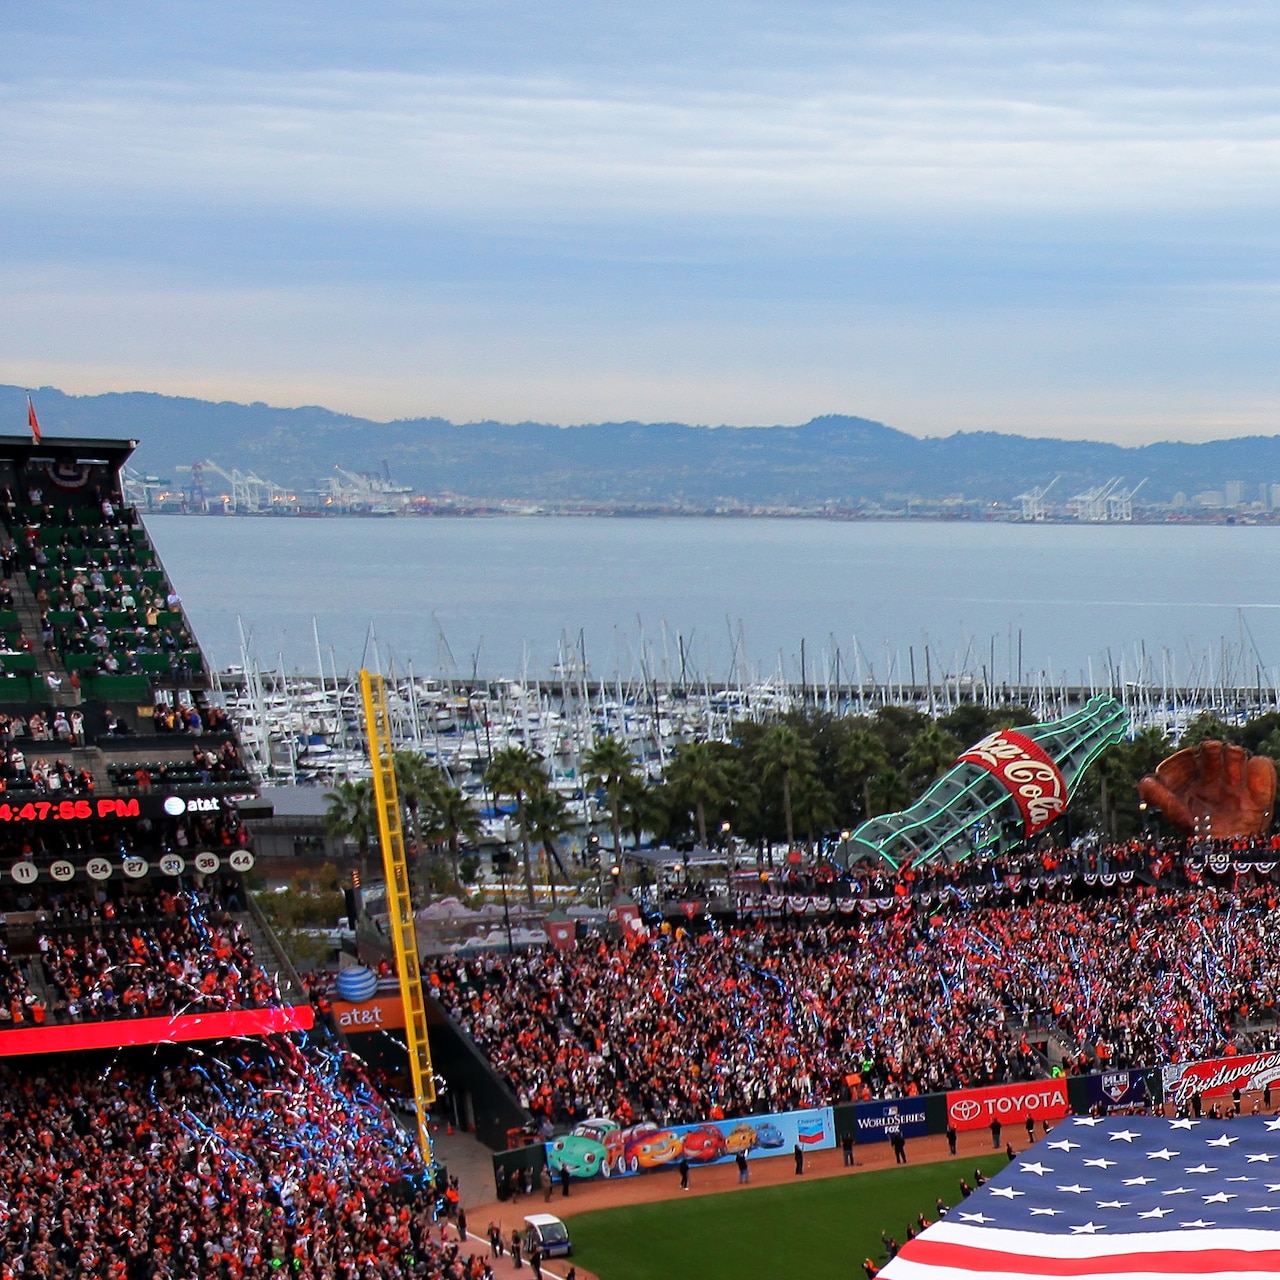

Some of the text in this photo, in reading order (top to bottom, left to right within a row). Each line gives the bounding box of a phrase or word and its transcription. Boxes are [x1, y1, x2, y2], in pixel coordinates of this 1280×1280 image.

[97, 798, 140, 818] PM
[187, 797, 221, 812] at&t
[200, 859, 215, 868] 36
[233, 856, 251, 866] 44
[1210, 854, 1230, 863] 501
[55, 865, 71, 876] 20
[91, 864, 109, 874] 24
[127, 861, 144, 872] 27
[19, 868, 30, 878] 11
[339, 1006, 383, 1026] at&t
[984, 1091, 1067, 1115] TOYOTA
[857, 1112, 926, 1129] WORLD SERIES
[884, 1125, 901, 1134] FOX
